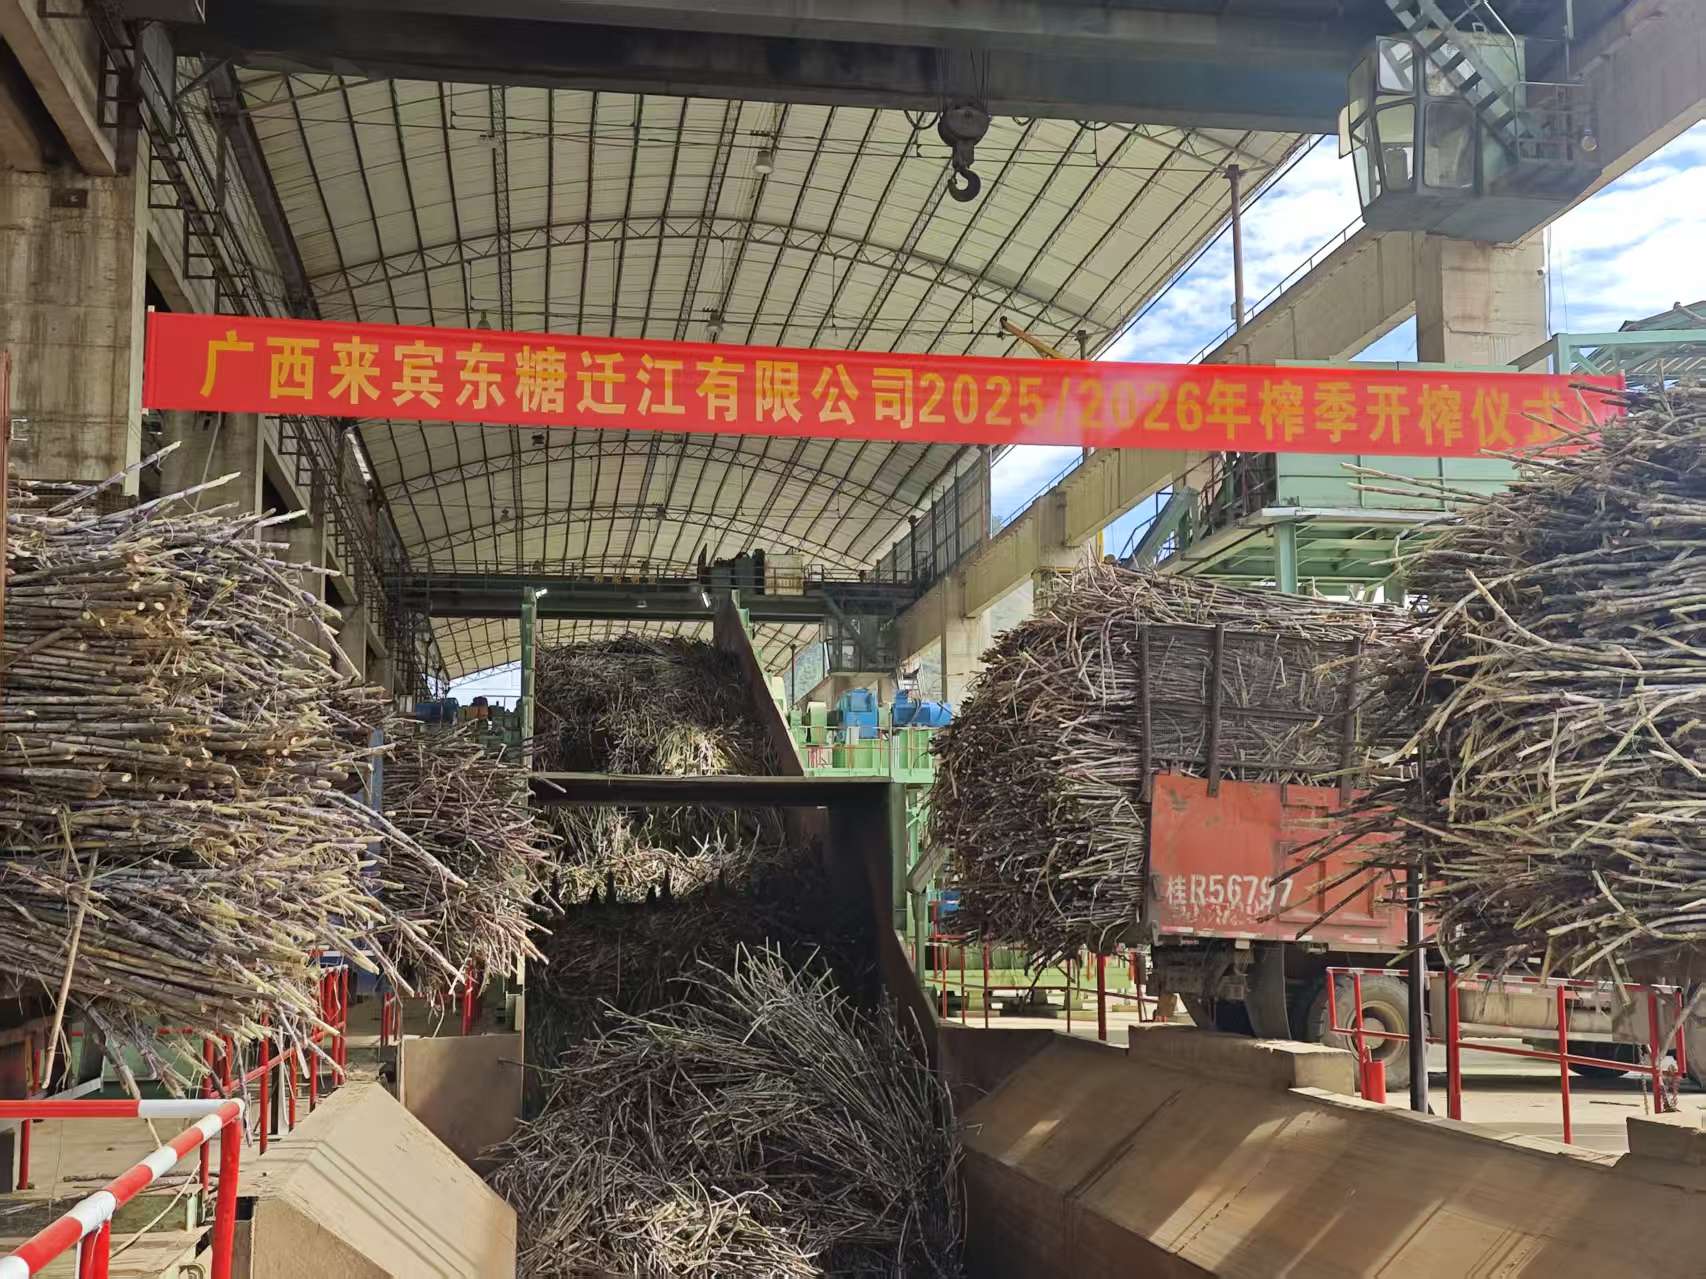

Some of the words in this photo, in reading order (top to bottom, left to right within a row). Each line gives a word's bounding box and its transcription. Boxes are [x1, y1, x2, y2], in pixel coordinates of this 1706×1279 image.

[200, 330, 1566, 445] 广西来宾东糖迁江有限公司2025/2026年榨季开榨仪式
